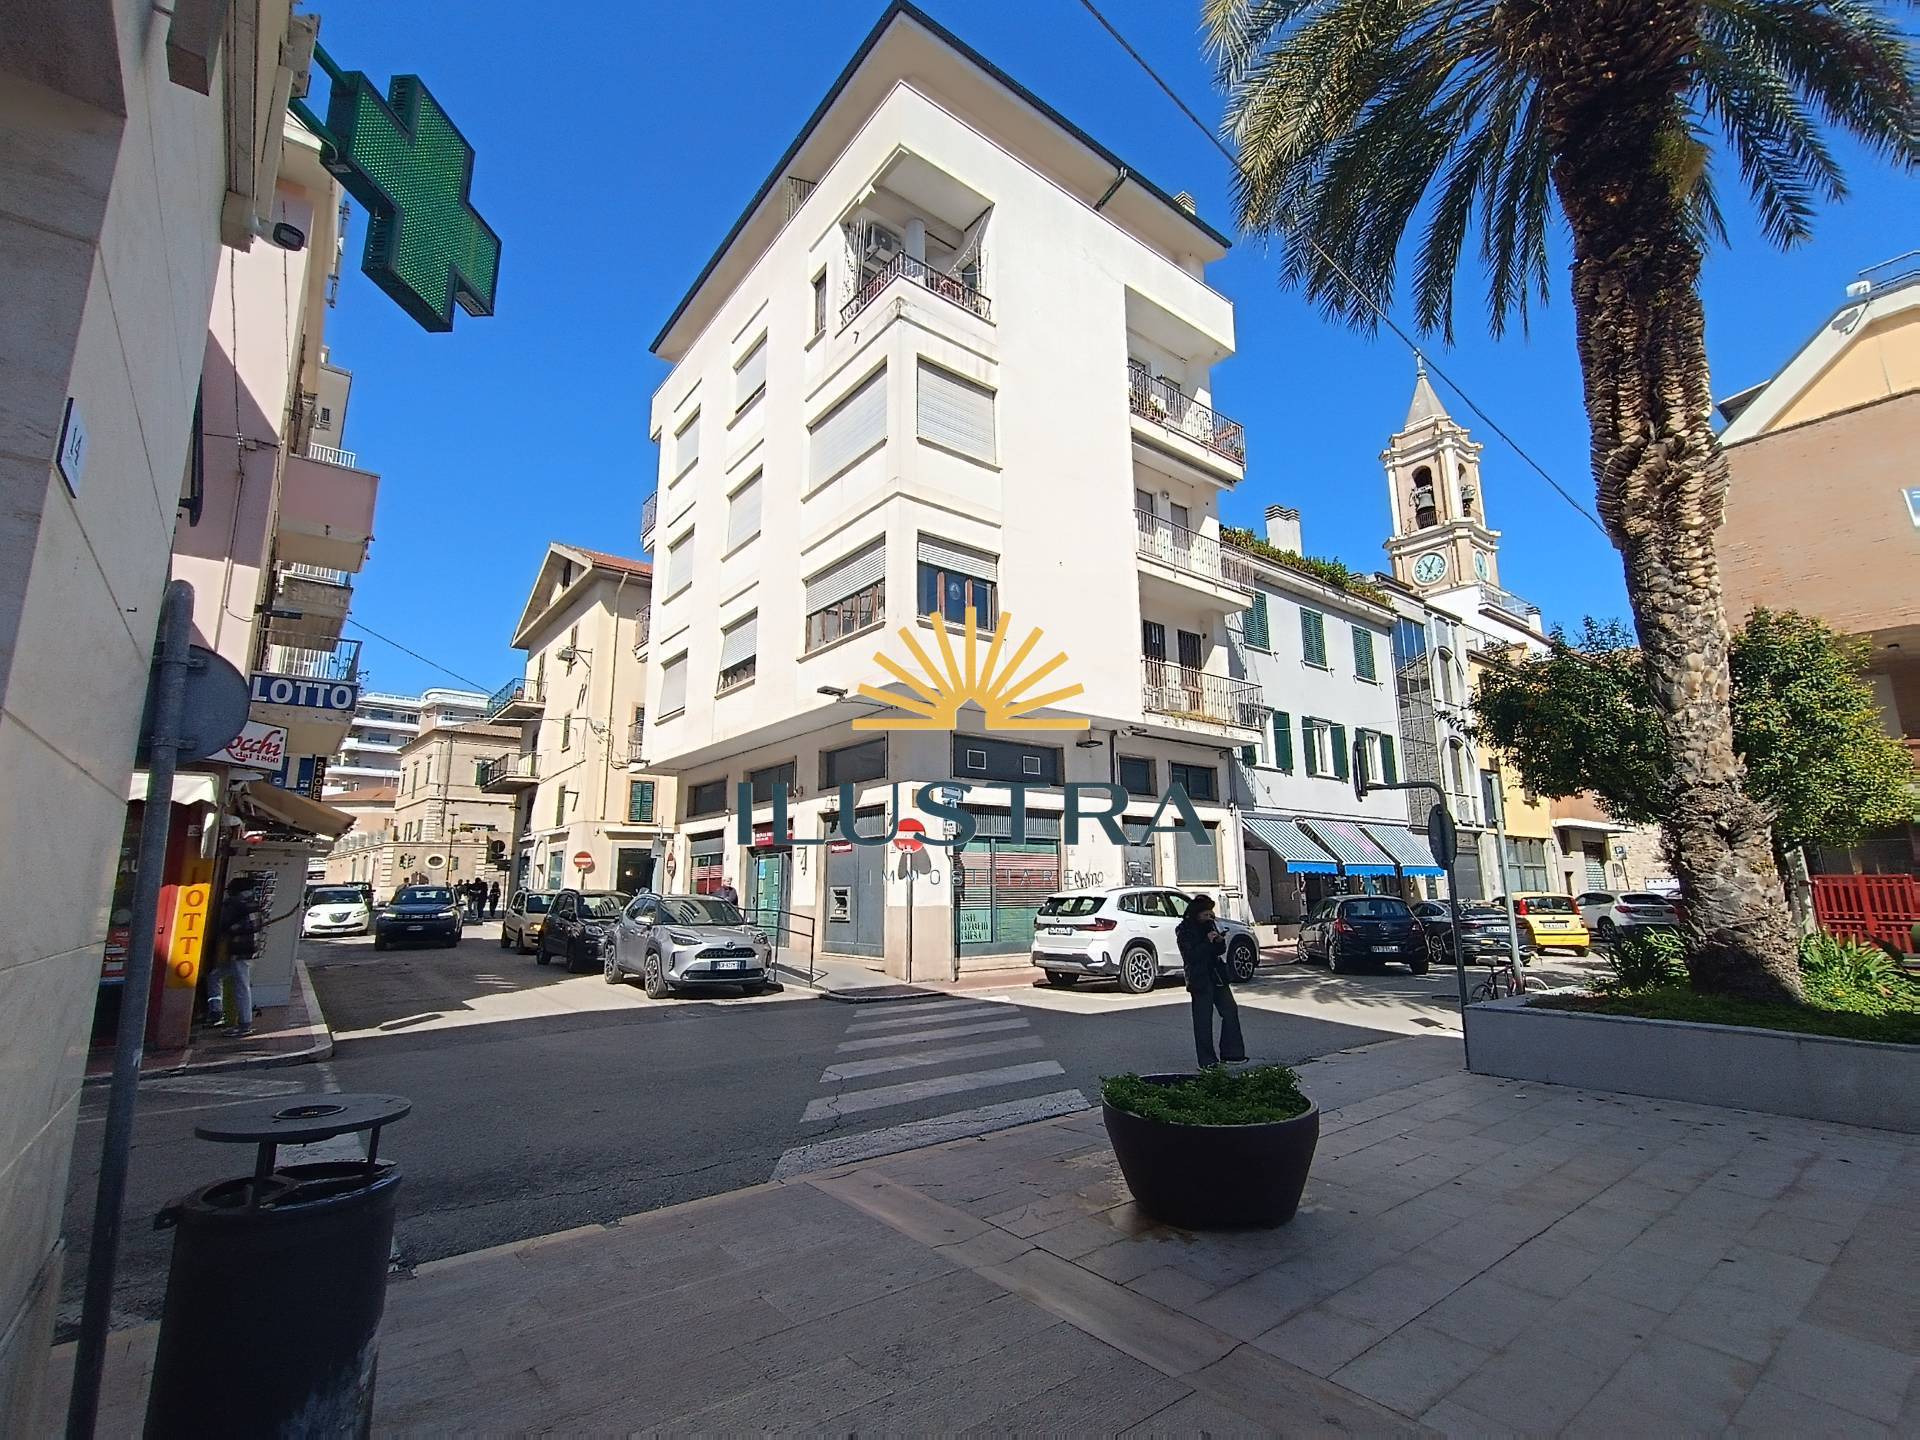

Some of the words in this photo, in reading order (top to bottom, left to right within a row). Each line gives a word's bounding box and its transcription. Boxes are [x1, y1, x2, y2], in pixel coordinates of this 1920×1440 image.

[251, 676, 353, 710] LOTTO
[225, 729, 283, 758] occhi
[235, 751, 252, 760] dal
[256, 754, 279, 765] 1860
